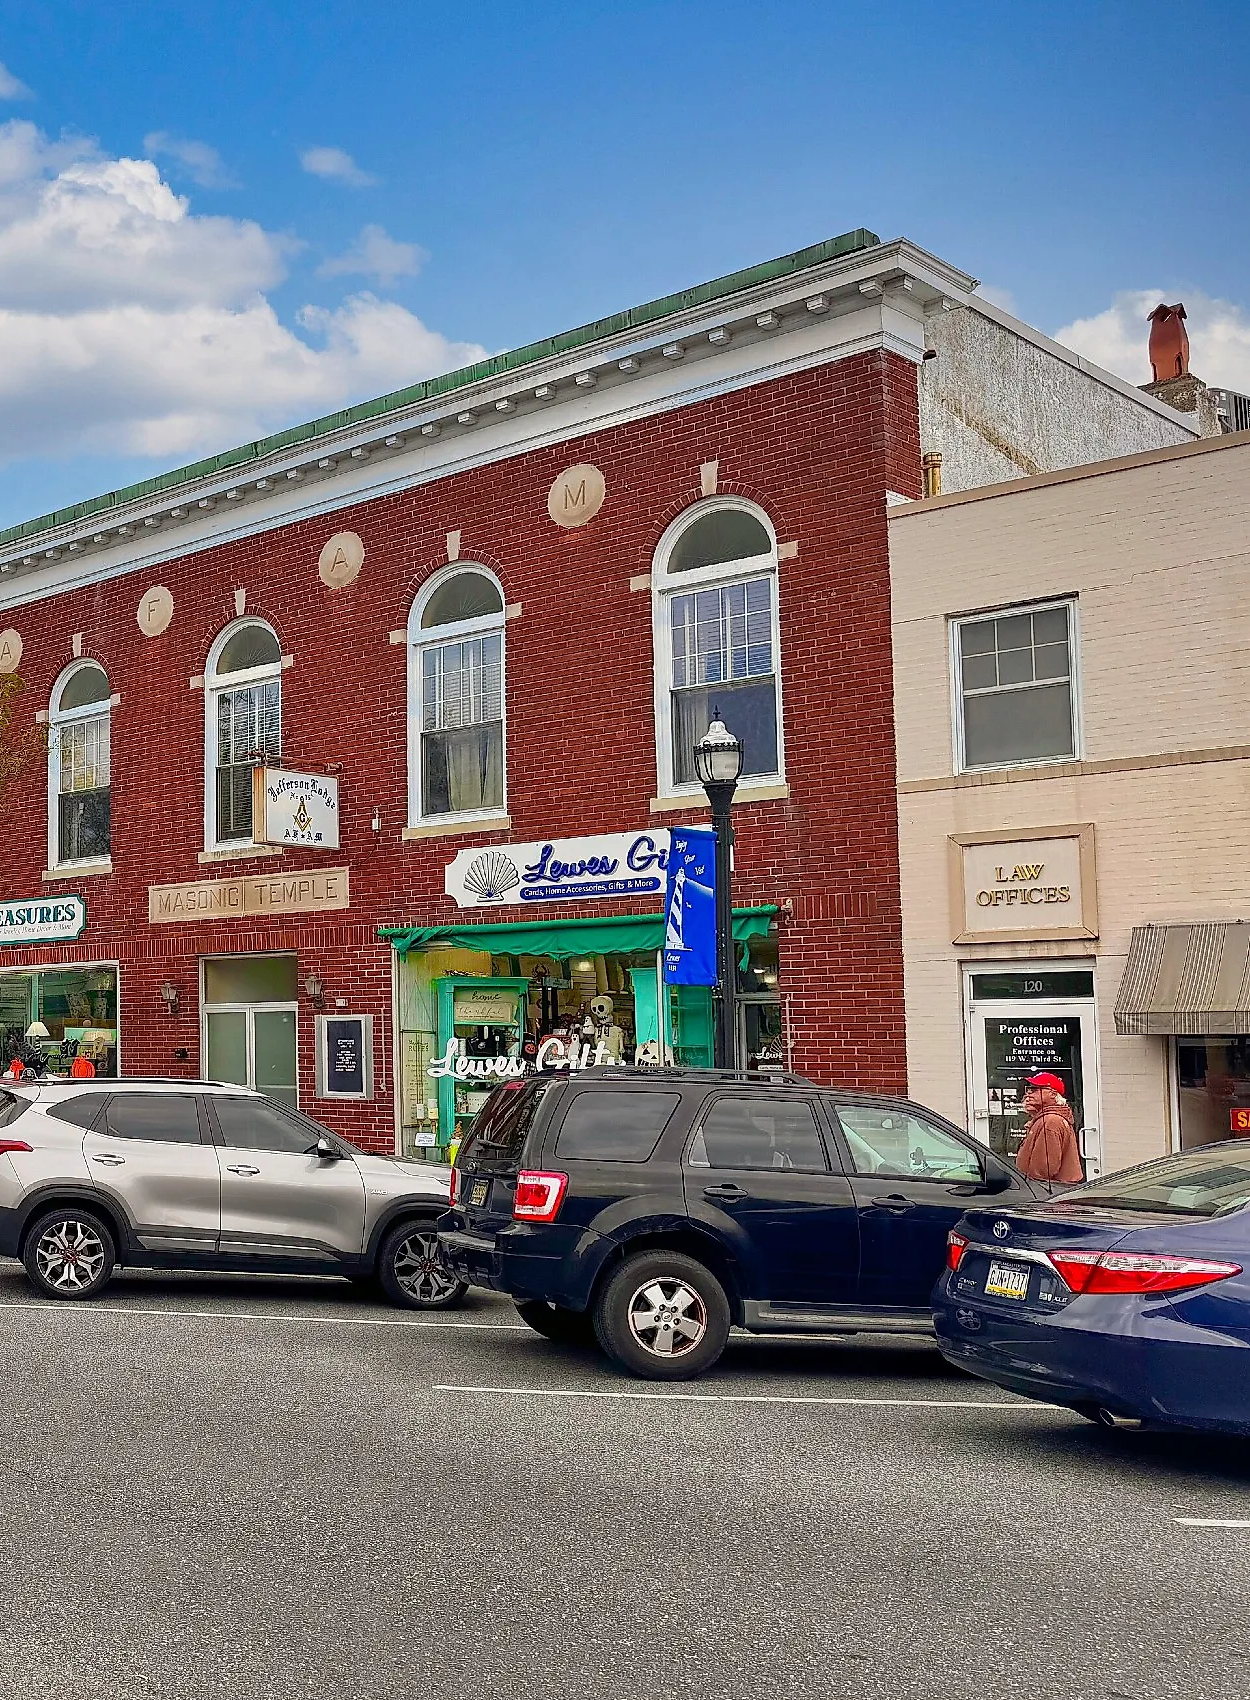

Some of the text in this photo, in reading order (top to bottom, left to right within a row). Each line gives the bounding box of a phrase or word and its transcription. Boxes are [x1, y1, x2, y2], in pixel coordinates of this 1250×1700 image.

[147, 598, 160, 621] F
[330, 547, 348, 572] A
[563, 479, 586, 509] M
[268, 778, 336, 810] Jefferson Lodge
[521, 843, 620, 883] Lewes
[994, 862, 1045, 883] LAW
[158, 877, 338, 914] MASONIC TEMPLE
[523, 879, 654, 898] Cards, Home Accessories, Gifts & More
[975, 885, 1071, 906] OFFICES
[1023, 980, 1043, 993] 120
[998, 1024, 1068, 1034] Professional
[1013, 1036, 1054, 1046] Offices
[427, 1037, 525, 1080] Lewes
[755, 1046, 783, 1060] Lewe
[1030, 1055, 1051, 1063] Third
[1052, 1055, 1064, 1063] St.
[1237, 1111, 1250, 1128] S
